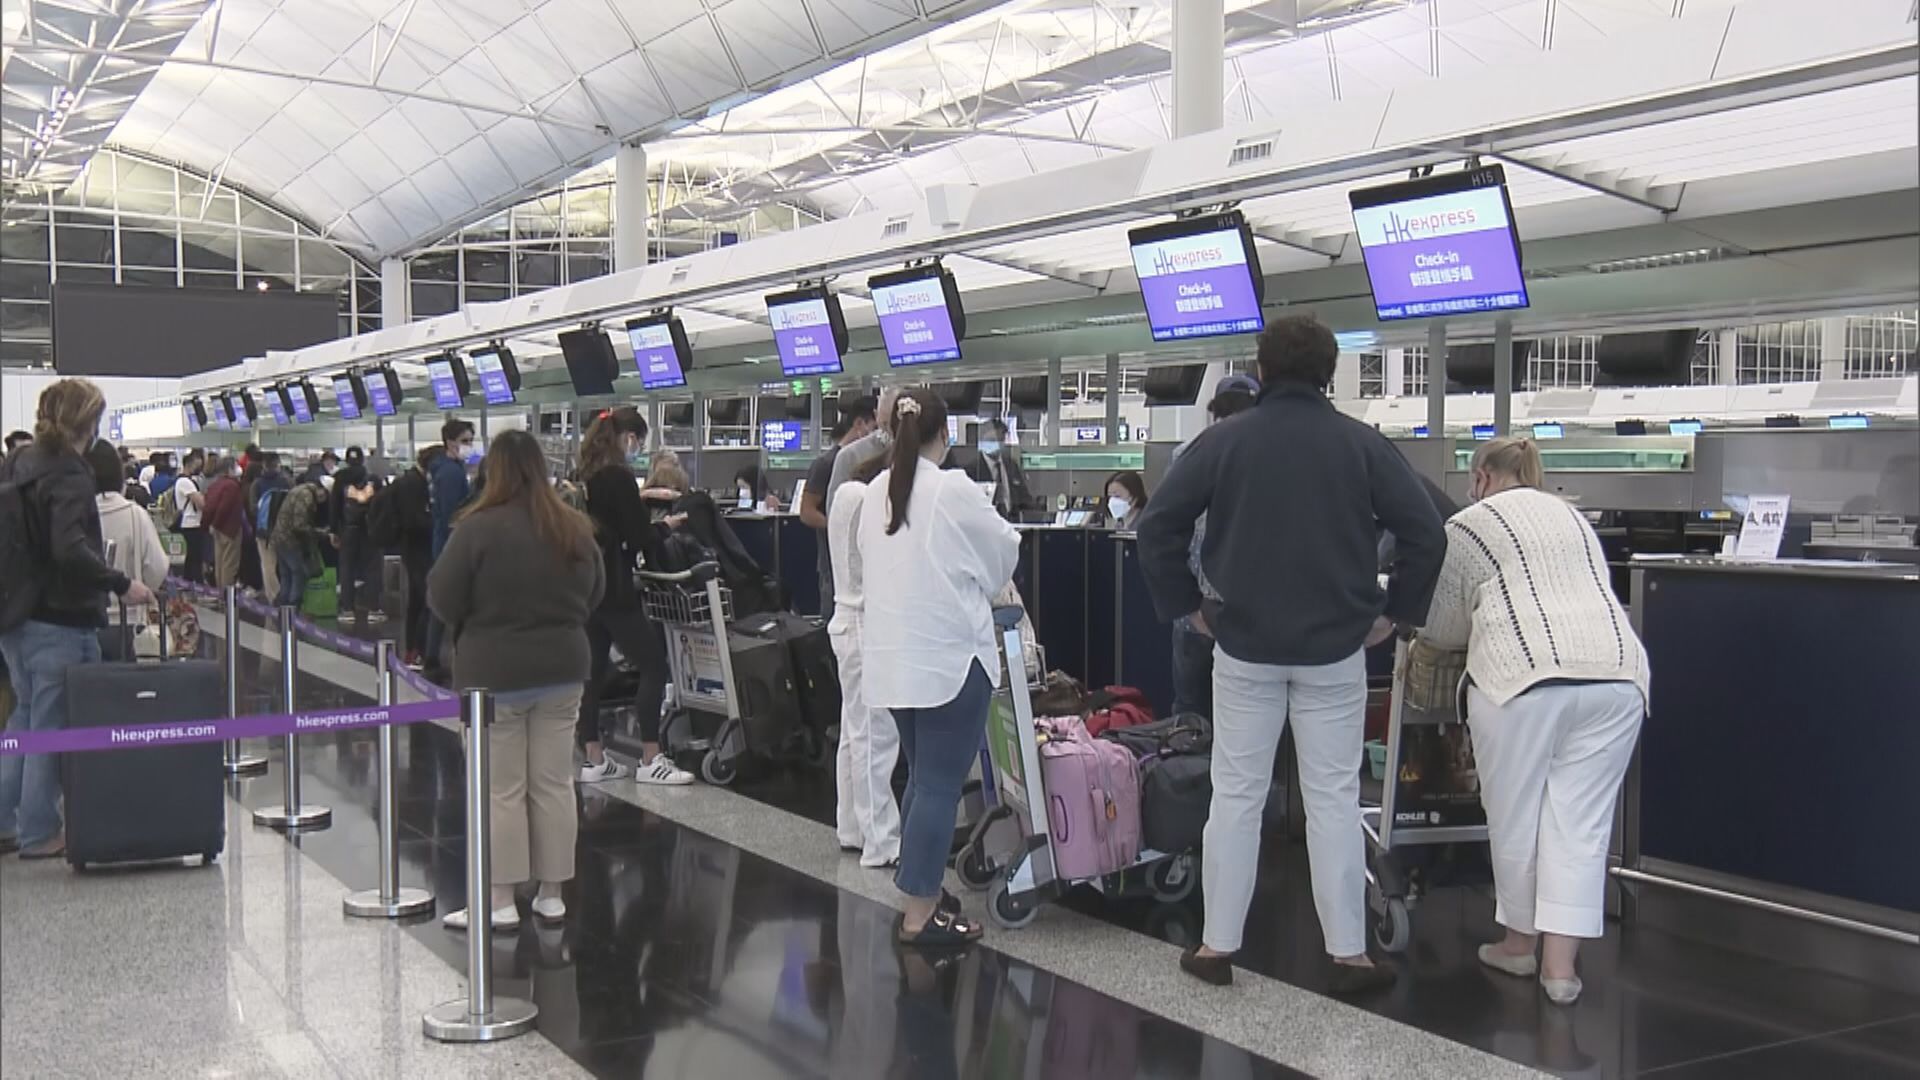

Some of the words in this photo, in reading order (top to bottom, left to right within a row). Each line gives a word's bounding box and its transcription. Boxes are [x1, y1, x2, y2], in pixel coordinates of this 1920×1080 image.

[1414, 250, 1460, 268] Check-in
[295, 710, 389, 729] hkexpress.com
[111, 724, 216, 743] hkexpress.com
